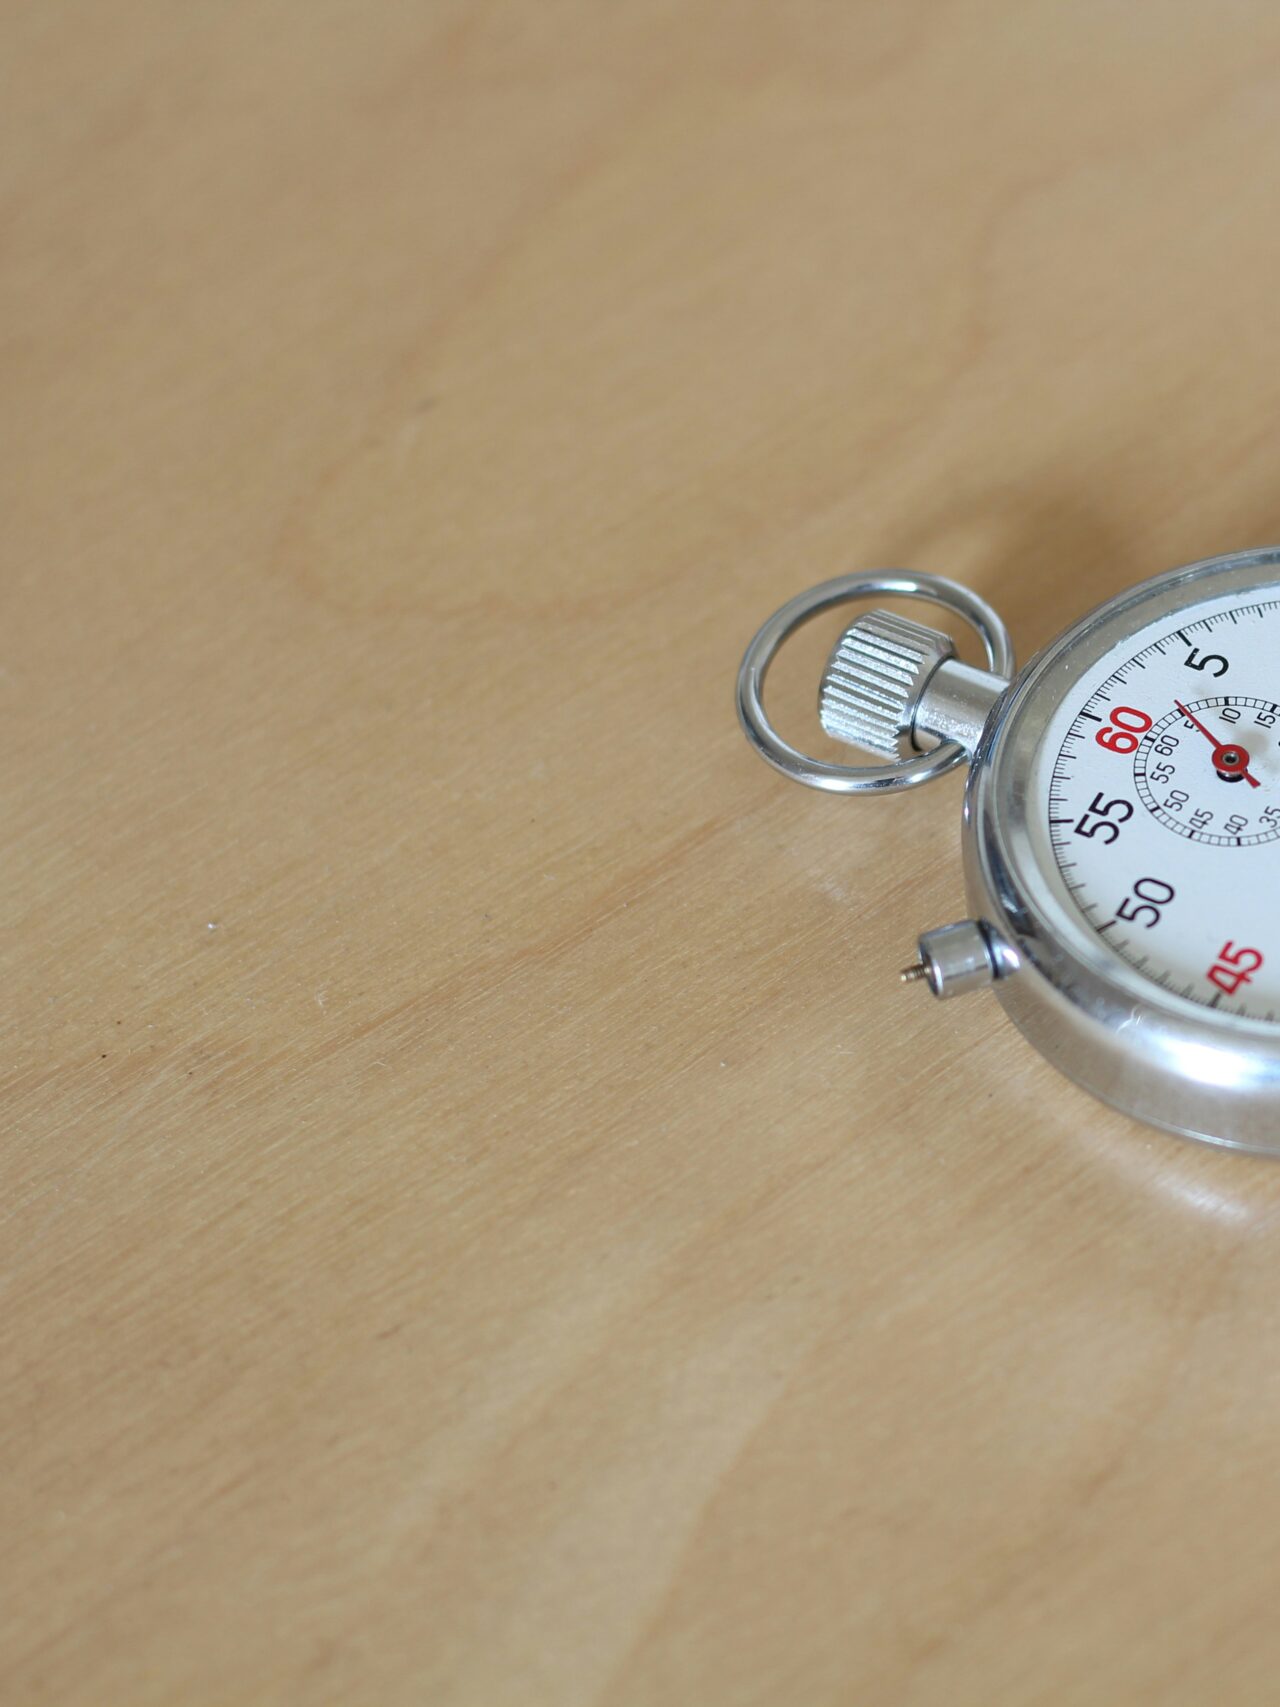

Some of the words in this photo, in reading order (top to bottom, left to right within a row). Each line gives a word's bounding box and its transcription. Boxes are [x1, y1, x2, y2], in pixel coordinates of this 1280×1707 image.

[1184, 646, 1229, 678] 5
[1219, 708, 1241, 724] 10
[1254, 711, 1276, 728] 15
[1095, 705, 1153, 755] 60
[1154, 734, 1180, 757] 60
[1150, 762, 1175, 784] 55
[1163, 789, 1189, 811] 50
[1075, 792, 1134, 846] 55
[1188, 808, 1214, 830] 45
[1223, 814, 1249, 835] 40
[1116, 877, 1174, 928] 50
[1206, 940, 1264, 996] 45
